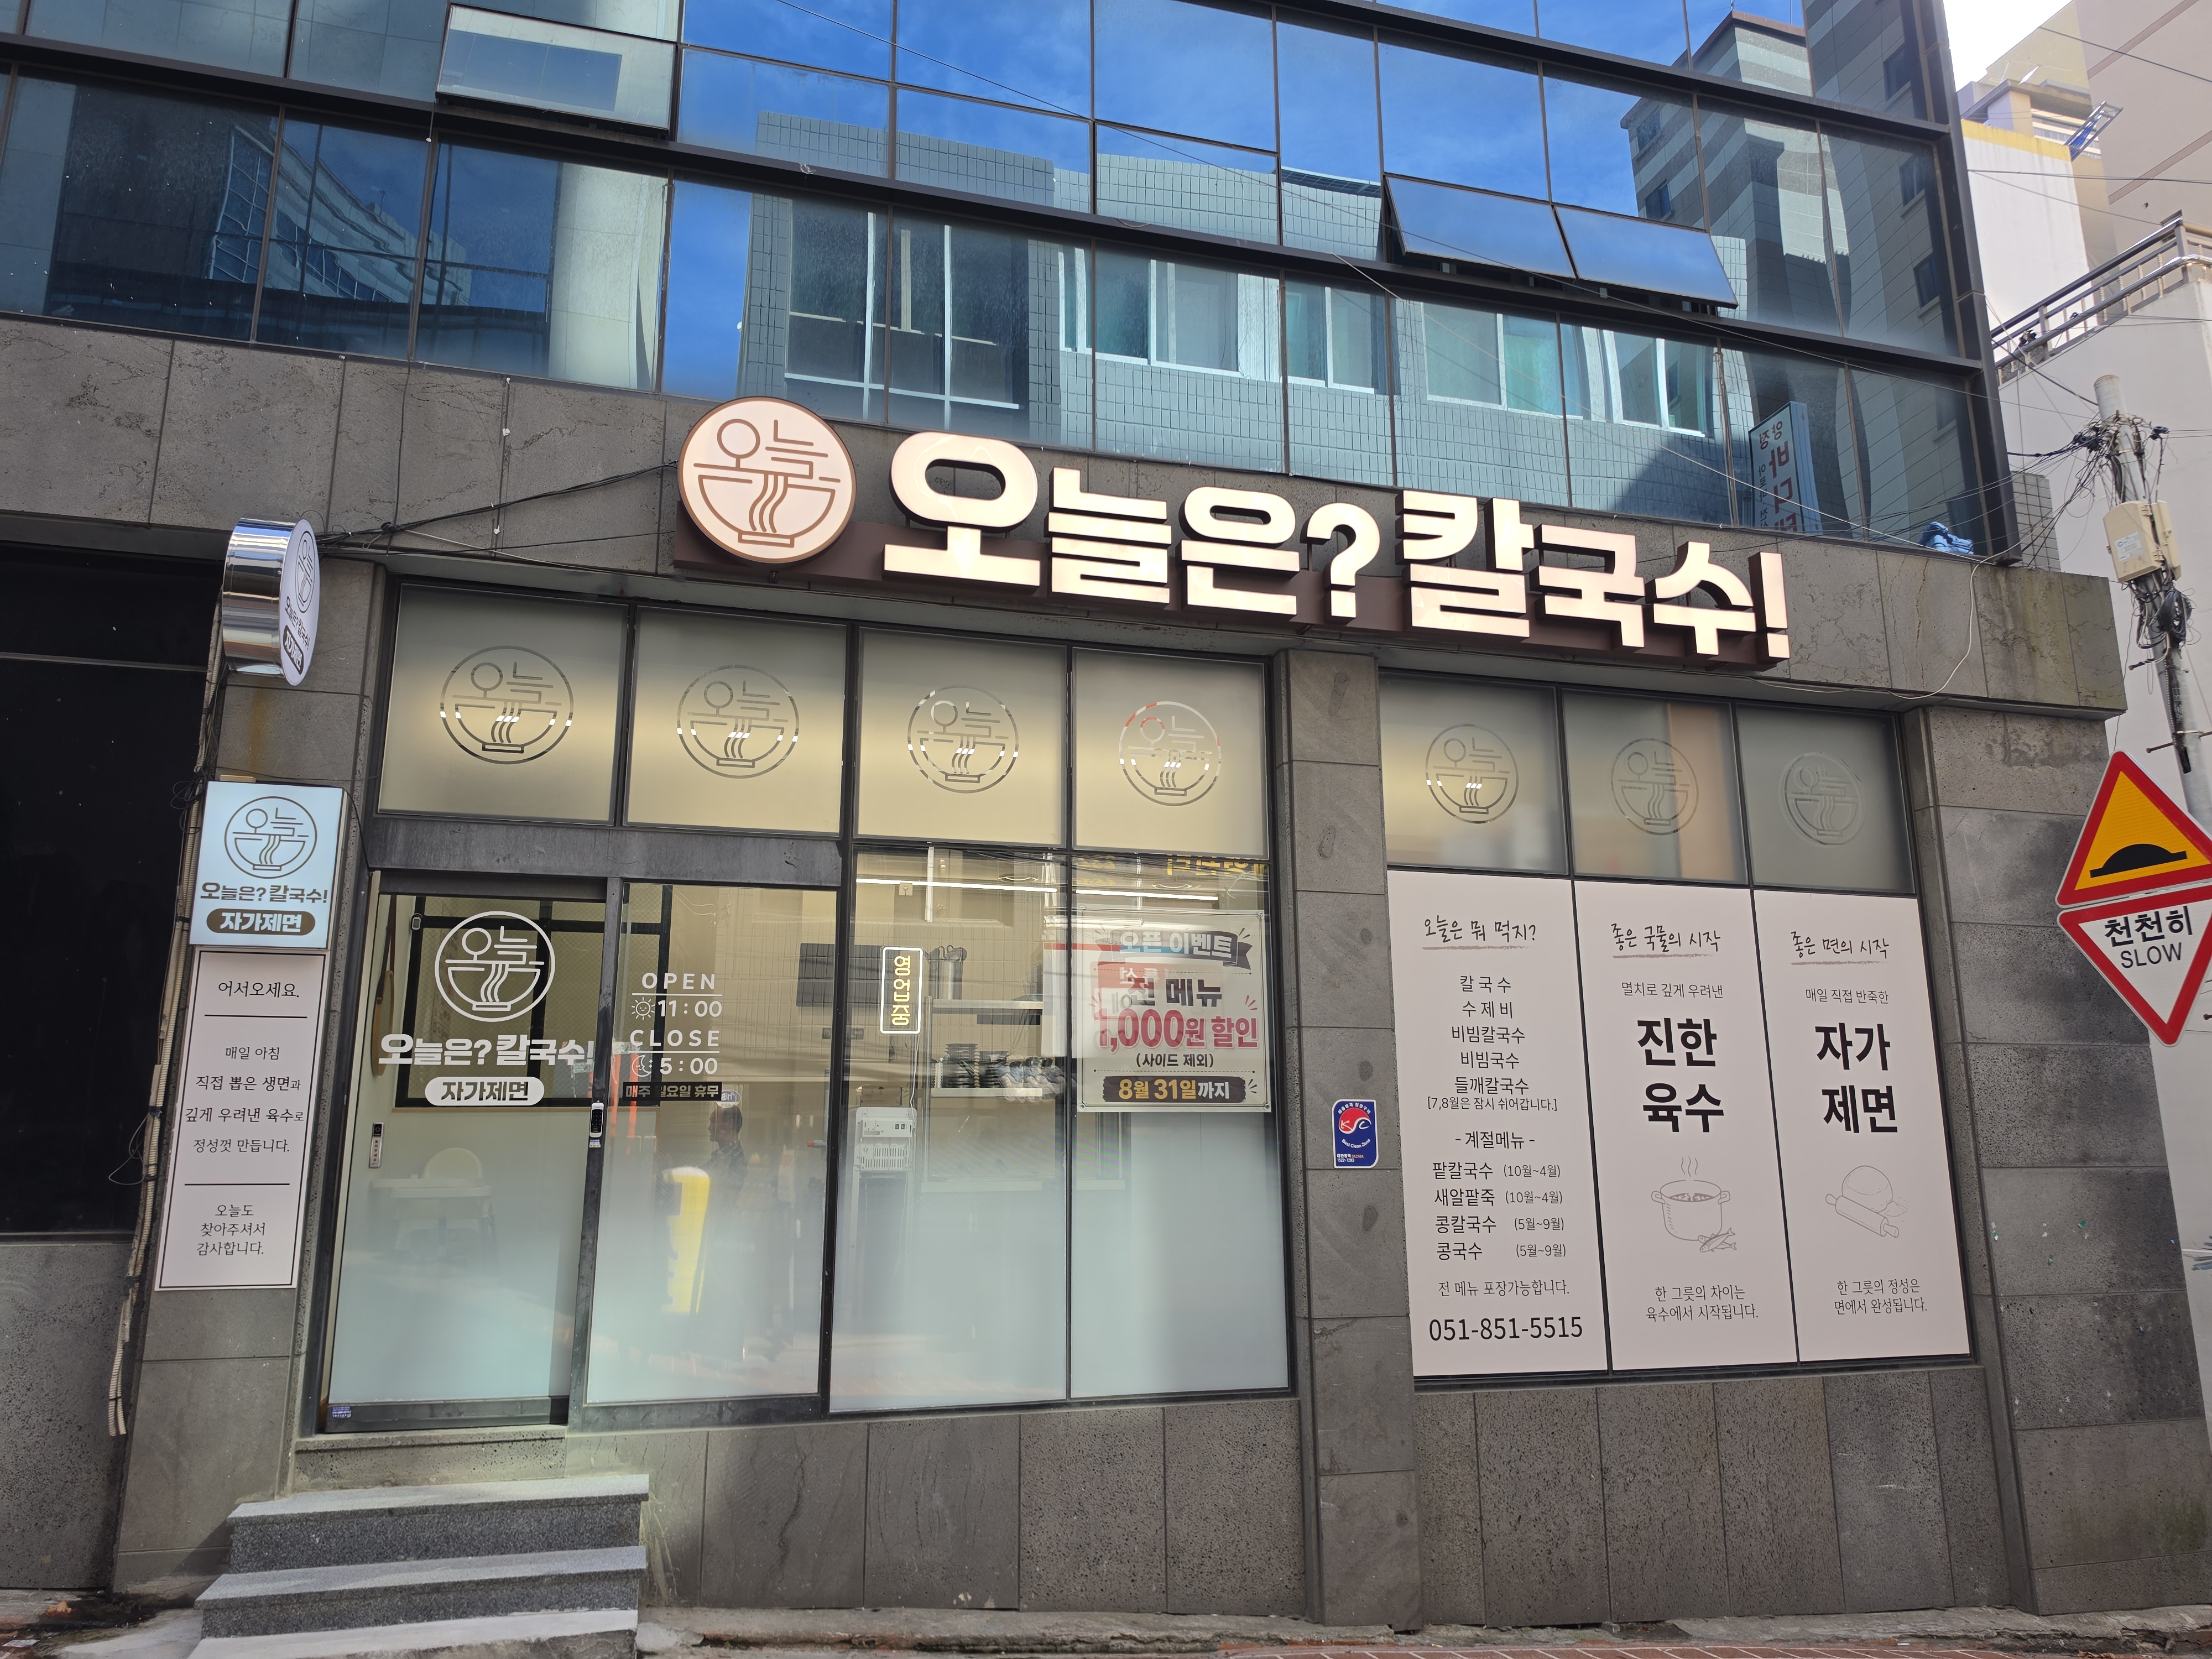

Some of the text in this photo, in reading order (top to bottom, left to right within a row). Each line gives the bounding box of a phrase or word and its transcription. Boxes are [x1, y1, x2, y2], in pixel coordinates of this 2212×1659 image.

[882, 431, 1790, 661] 오늘은? 칼국수!
[284, 630, 303, 671] 자가제면
[200, 881, 327, 903] 오늘은? 칼국수!
[220, 912, 302, 933] 자가제면
[1424, 915, 1537, 943] 오늘은 뭐 먹지?
[2104, 905, 2193, 947] 천천히
[1119, 931, 1233, 959] 오픈 이벤트
[1610, 923, 1721, 953] 좋은 국물의 시작
[1791, 931, 1890, 959] 좋은 면의 시작
[2120, 942, 2182, 969] SLOW
[218, 980, 300, 998] 어서오세요.
[641, 972, 716, 991] OPEN
[891, 954, 911, 1026] 영업중
[1621, 982, 1724, 999] 멸치로 깊게 우려낸
[1127, 977, 1156, 1008] 전
[1166, 978, 1223, 1006] 메뉴
[1805, 988, 1889, 1005] 매일 직접 반죽한
[629, 1029, 721, 1047] CLOSE
[1212, 1015, 1259, 1048] 할인
[1451, 1025, 1525, 1045] 비빔칼국수
[1636, 1016, 1718, 1067] 진한
[225, 1046, 281, 1061] 매일 아침
[378, 1033, 594, 1067] 오늘은? 칼국수!
[1814, 1022, 1891, 1071] 자가
[1135, 1051, 1215, 1069] (사이드 제외)
[1460, 1051, 1520, 1070] 비빔국수
[195, 1075, 301, 1092] 직접 뽑은 생면과
[440, 1080, 529, 1102] 자가제면
[625, 1084, 651, 1098] 매주
[694, 1084, 719, 1098] 휴무
[1119, 1078, 1230, 1101] 8월 31일까지
[1454, 1077, 1530, 1095] 들깨칼국수
[1427, 1097, 1558, 1112] [7,8월은 잠시 쉬어갑니다.]
[1642, 1082, 1724, 1134] 육수
[1821, 1084, 1898, 1134] 제면
[185, 1107, 304, 1123] 깊게 우려낸 육수로
[192, 1139, 290, 1154] 정성껏 만듭니다.
[1432, 1161, 1561, 1181] 팥칼국수 (10월~4월)
[1434, 1188, 1563, 1207] 새알팥죽 (10월~4월)
[214, 1203, 254, 1218] 오늘도
[200, 1222, 266, 1237] 찾아주셔서
[1435, 1214, 1565, 1234] 콩칼국수 (5월~9월)
[196, 1241, 264, 1256] 감사합니다.
[1436, 1241, 1566, 1261] 콩국수 (5월~9월)
[1438, 1279, 1570, 1297] 전 메뉴 포장가능합니다.
[1655, 1284, 1746, 1302] 한 그릇의 차이는
[1837, 1278, 1921, 1295] 한 그릇의 정성은
[1646, 1303, 1759, 1322] 육수에서 시작됩니다.
[1834, 1297, 1928, 1316] 면에서 완성됩니다.
[1429, 1316, 1583, 1342] 051-851-5515
